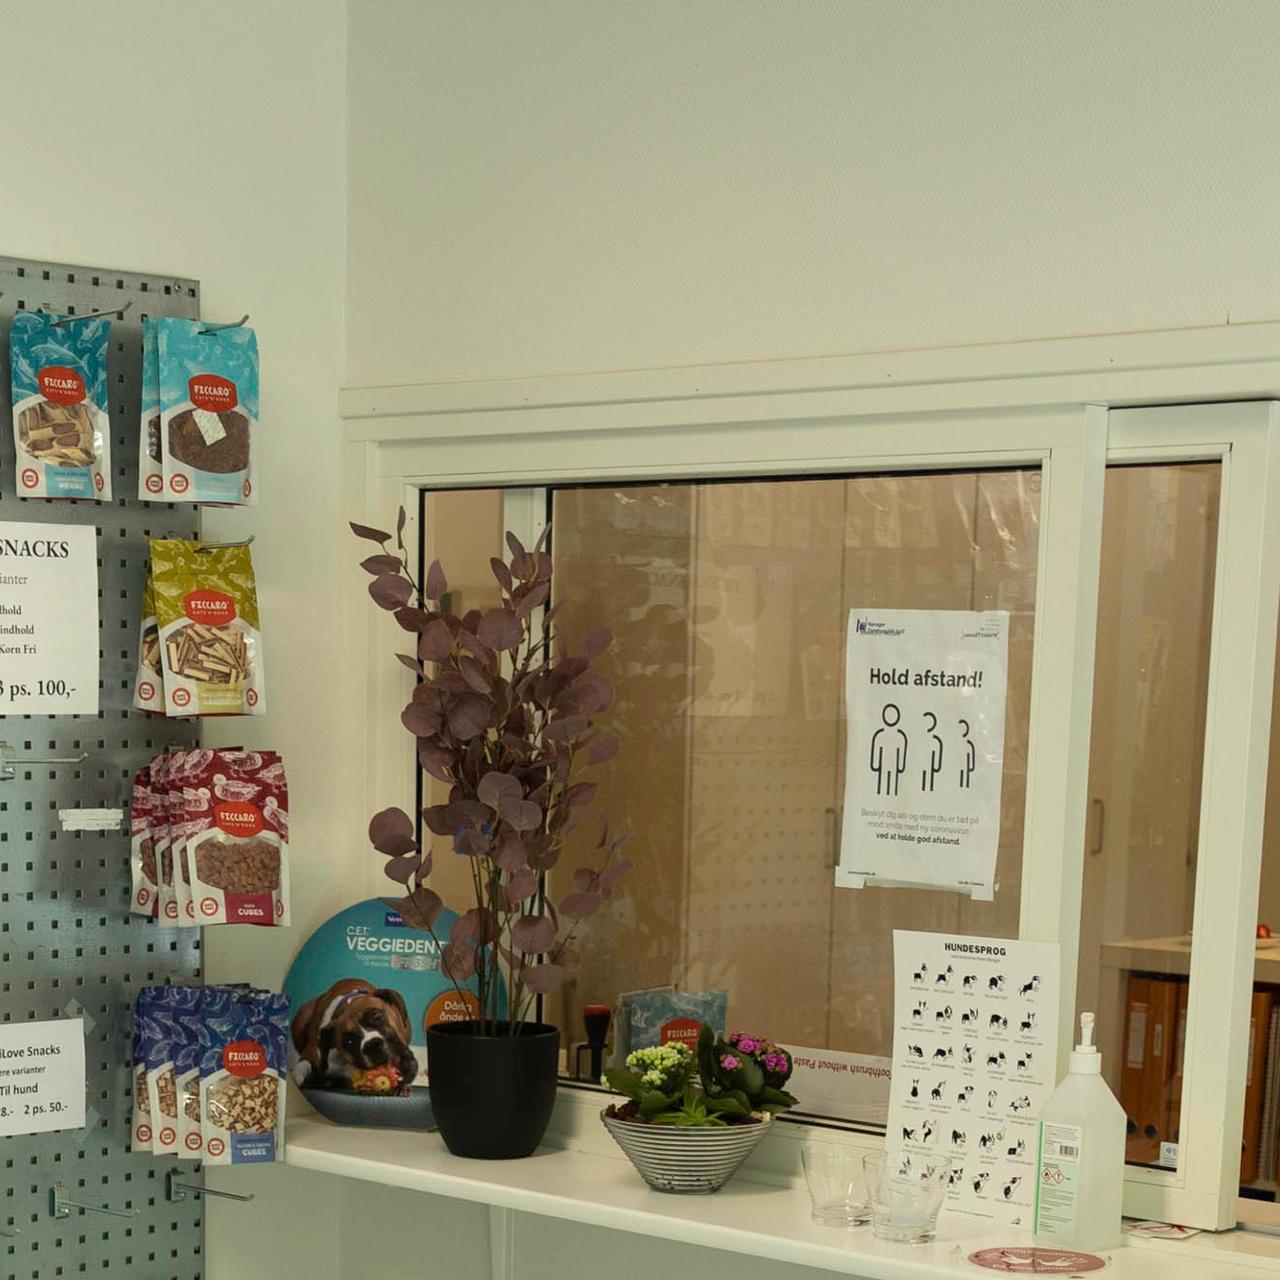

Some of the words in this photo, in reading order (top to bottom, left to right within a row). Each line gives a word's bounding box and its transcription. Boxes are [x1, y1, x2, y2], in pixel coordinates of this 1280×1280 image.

[44, 376, 79, 389] FICCARO
[194, 384, 232, 397] FICCARO
[191, 600, 228, 610] FICCARO
[0, 624, 35, 635] indhold
[23, 644, 37, 655] Fri
[870, 668, 909, 686] Hold
[913, 669, 983, 688] afstand!
[10, 684, 31, 702] ps.
[37, 680, 77, 699] 100,-
[220, 812, 255, 822] FICCARO
[861, 809, 885, 819] Beskyt
[876, 832, 889, 840] ved
[916, 835, 931, 844] god
[932, 836, 960, 845] afstand.
[944, 943, 1007, 956] HUNDESPROG
[27, 1044, 61, 1058] Snacks
[228, 1052, 260, 1061] FICCARO
[793, 1056, 816, 1069] Paste
[818, 1060, 848, 1073] without
[11, 1065, 46, 1076] varianter
[850, 1064, 892, 1080] oothbrush
[13, 1083, 39, 1096] hund
[32, 1105, 47, 1117] ps.
